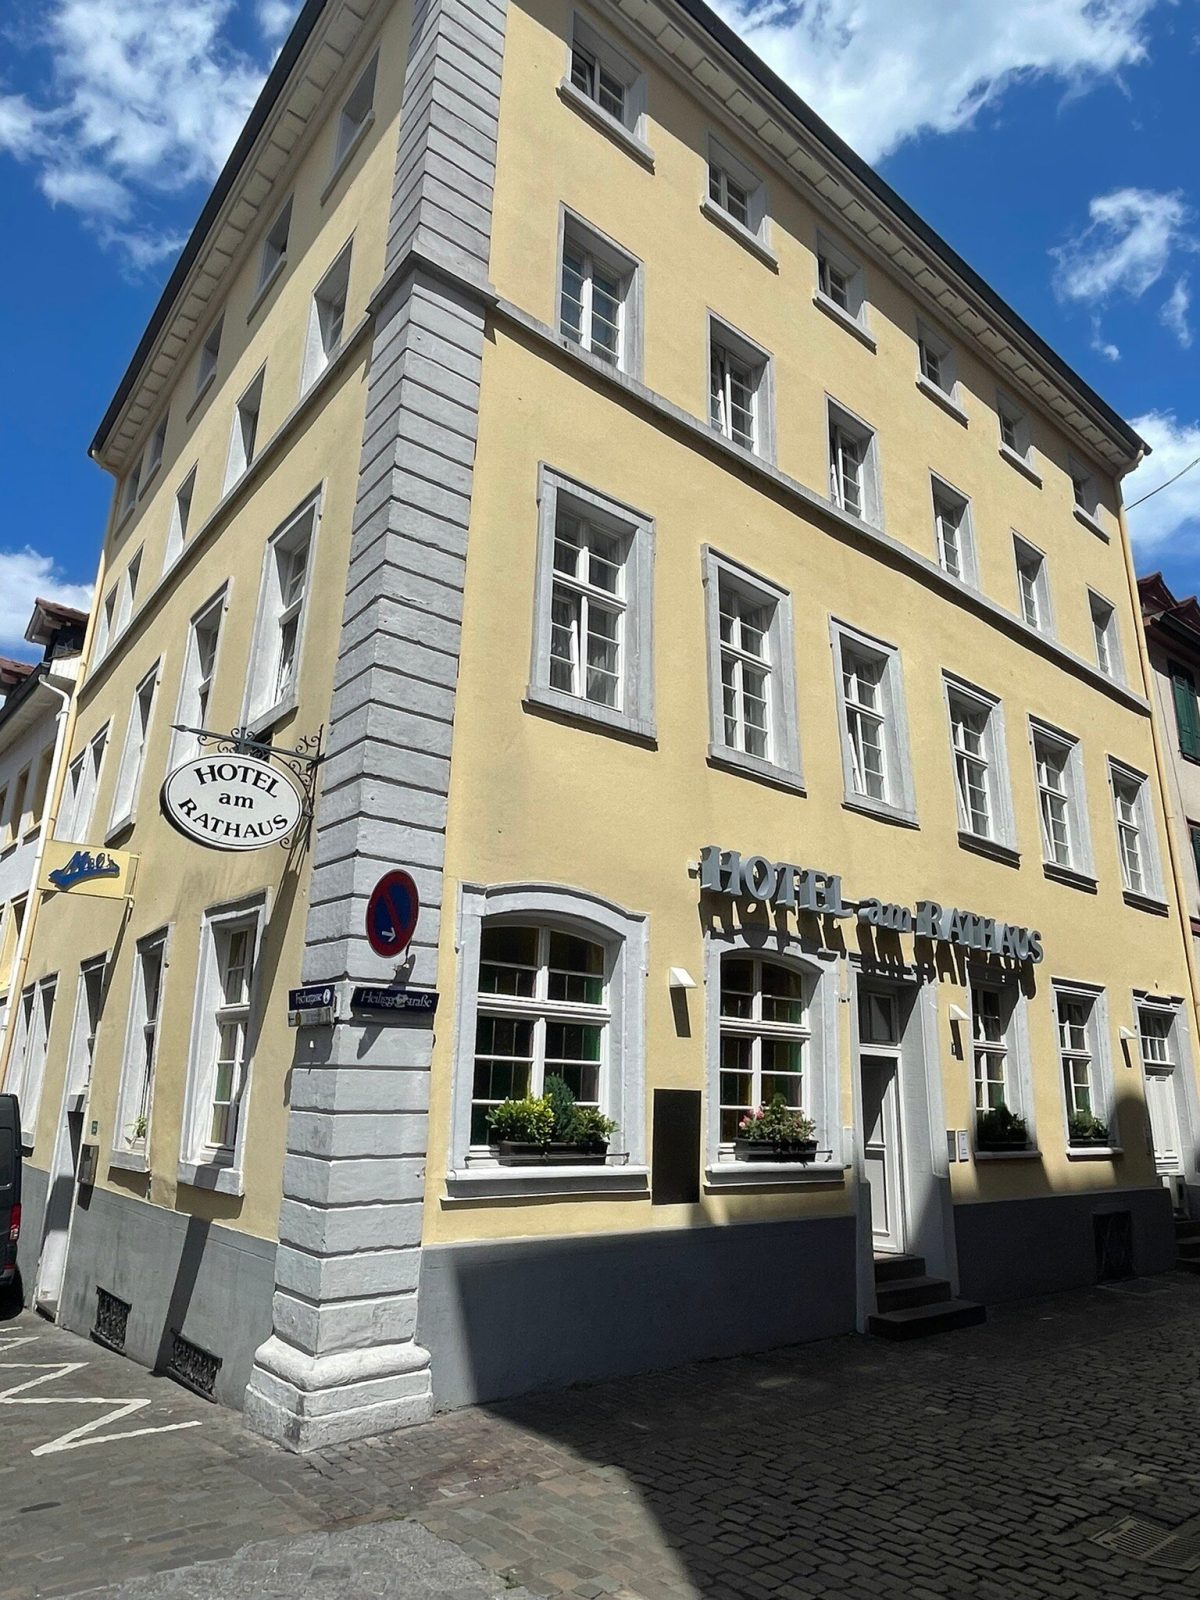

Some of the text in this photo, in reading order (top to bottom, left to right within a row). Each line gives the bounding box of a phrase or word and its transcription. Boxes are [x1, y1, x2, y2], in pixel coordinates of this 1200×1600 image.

[194, 763, 280, 799] HOTEL
[178, 798, 288, 839] RATHAUS
[218, 792, 255, 809] am
[699, 845, 1044, 964] HOTEL am RATHAUS
